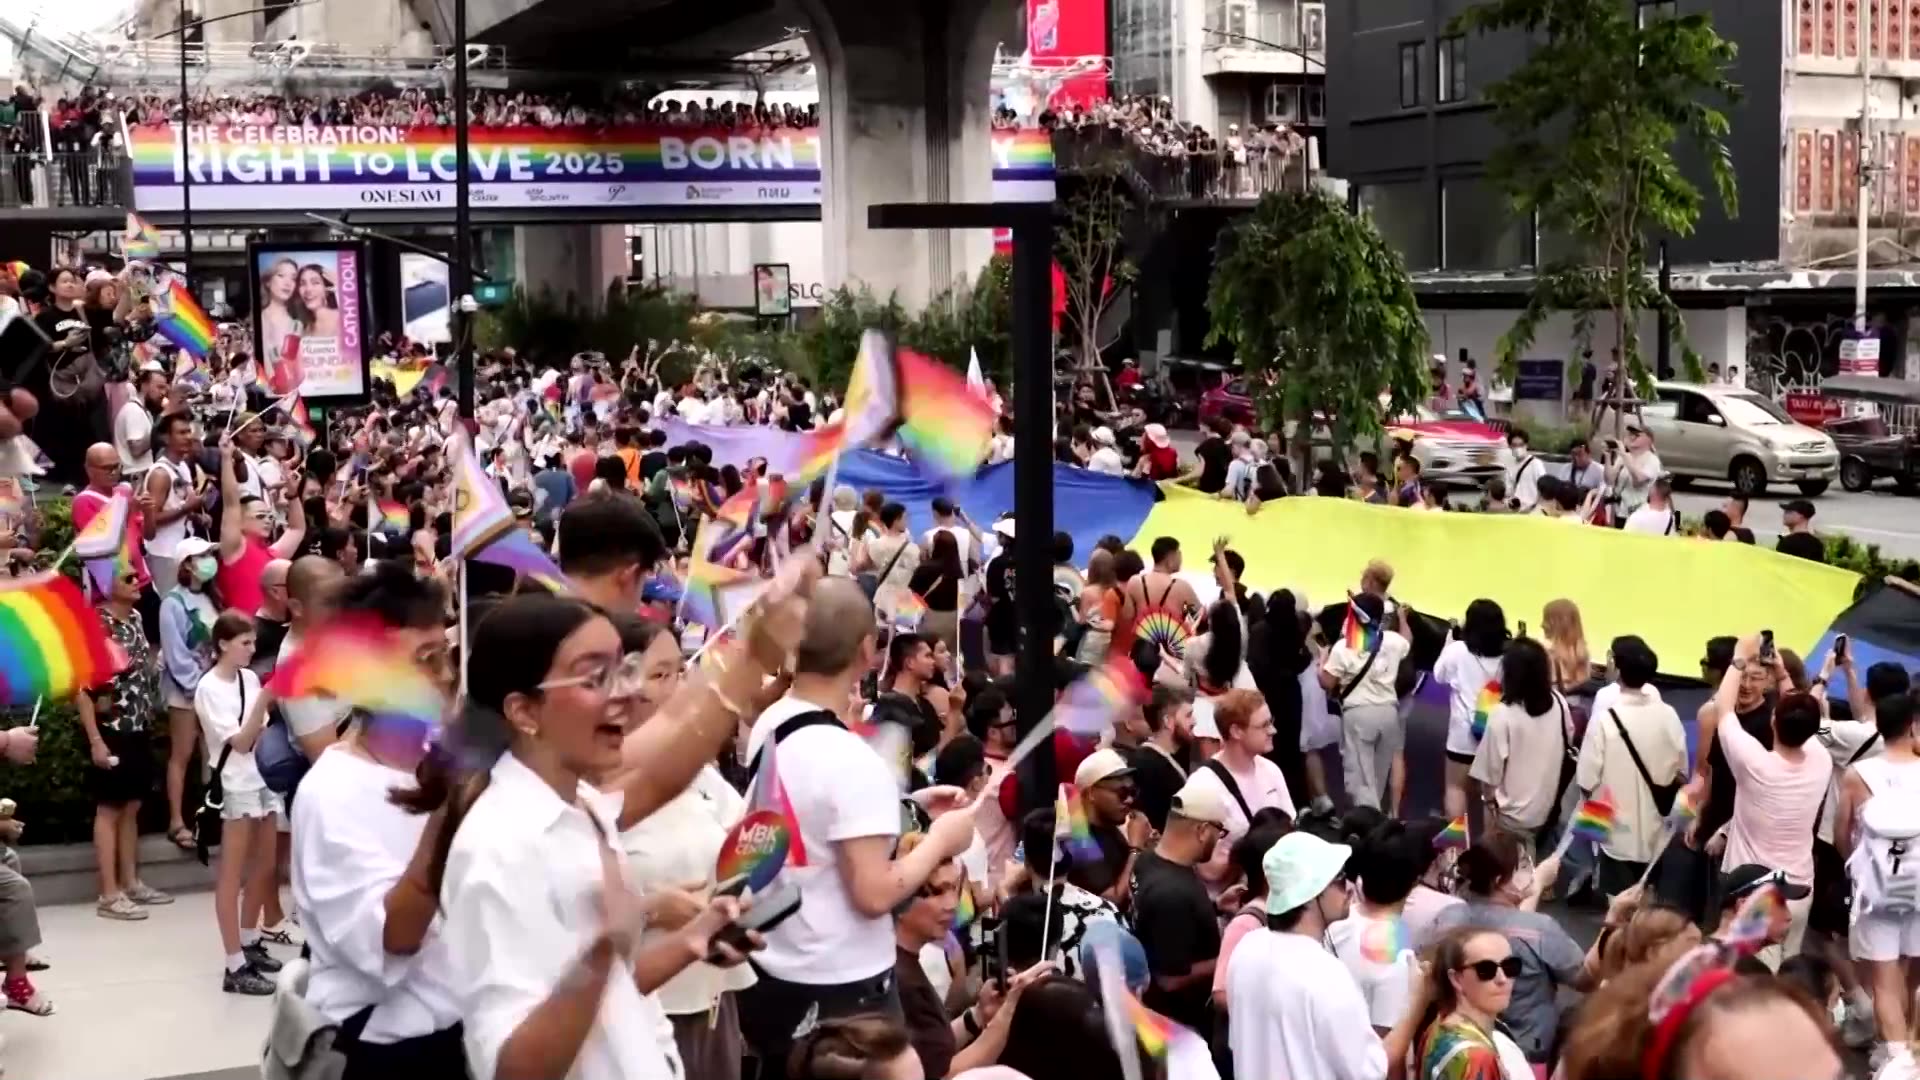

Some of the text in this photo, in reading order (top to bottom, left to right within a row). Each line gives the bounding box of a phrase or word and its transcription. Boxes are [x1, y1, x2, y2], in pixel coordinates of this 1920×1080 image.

[171, 125, 405, 145] THE CELEBRATION:
[173, 146, 625, 183] RIGHT TO LOVE 2025
[658, 136, 795, 170] BORN
[361, 190, 441, 204] ONESIAM
[340, 255, 358, 348] CATHY DOLL
[738, 822, 780, 842] MBK
